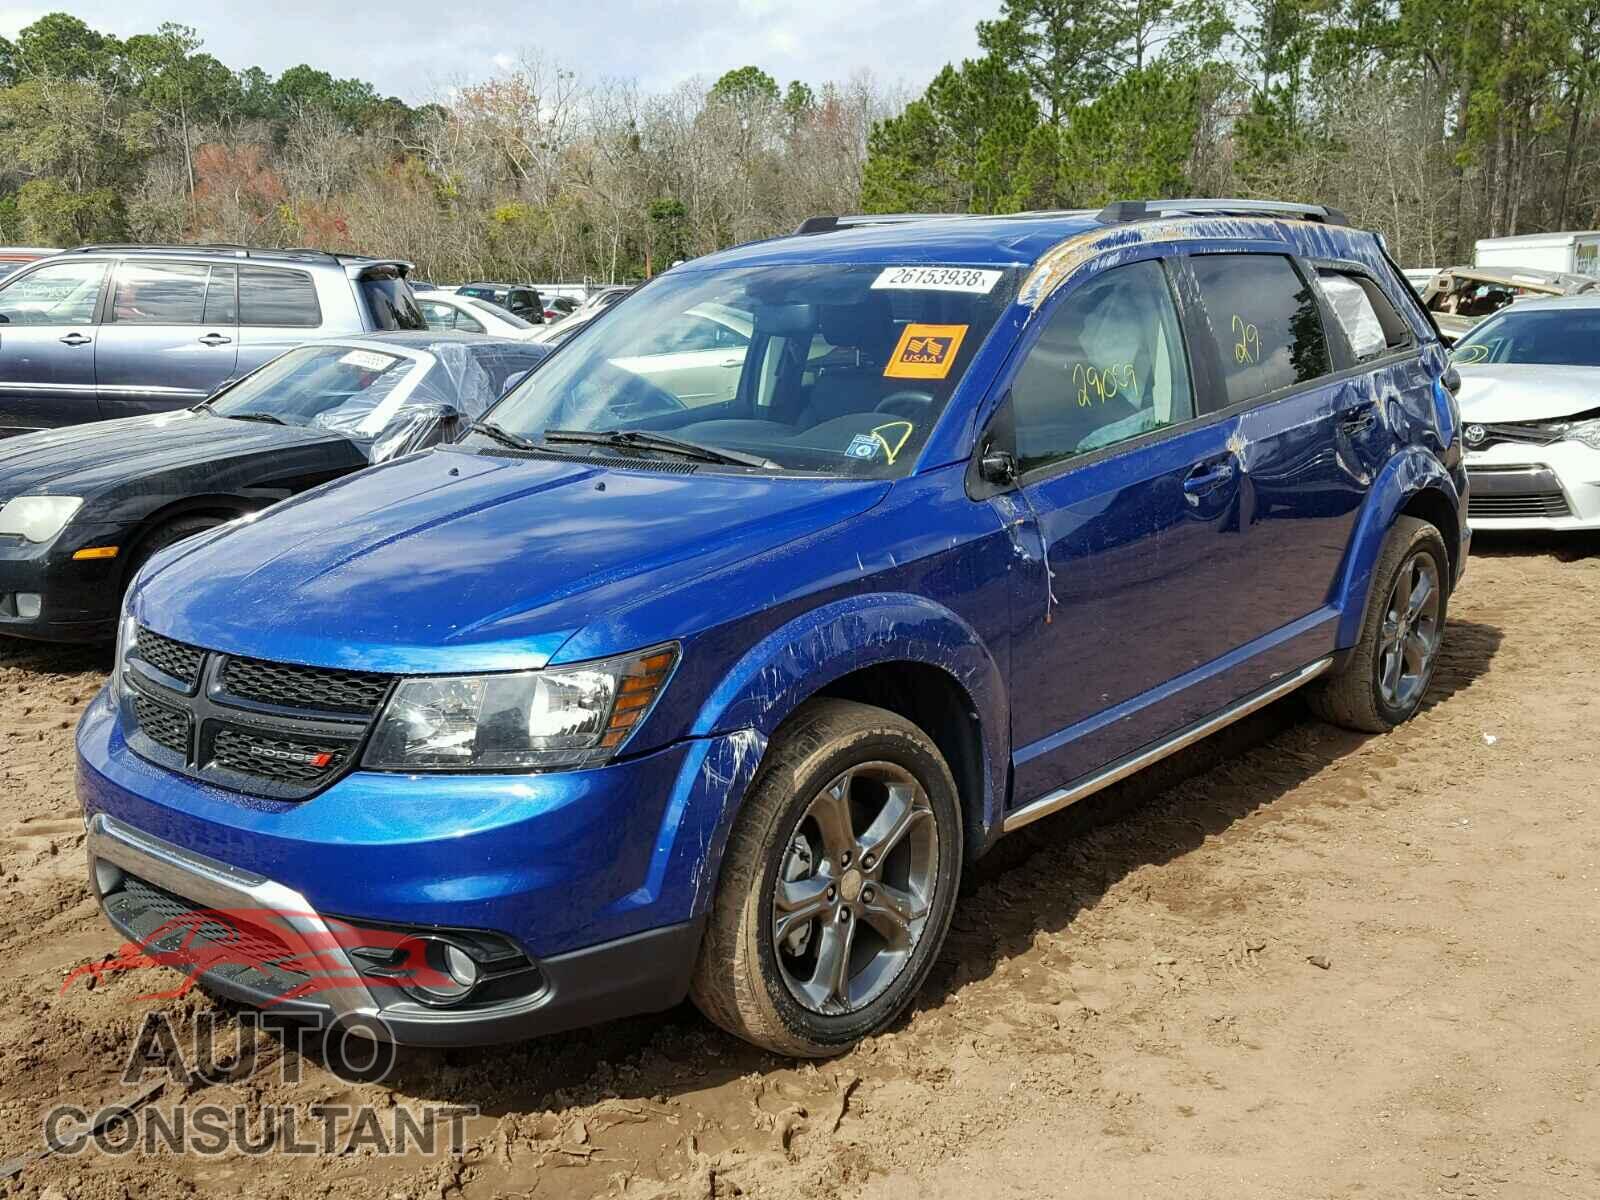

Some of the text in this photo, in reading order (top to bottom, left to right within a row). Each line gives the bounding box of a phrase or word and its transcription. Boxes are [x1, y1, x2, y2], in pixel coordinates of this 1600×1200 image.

[889, 268, 983, 287] 26153938
[902, 354, 937, 363] USAA
[250, 746, 315, 762] DODGE
